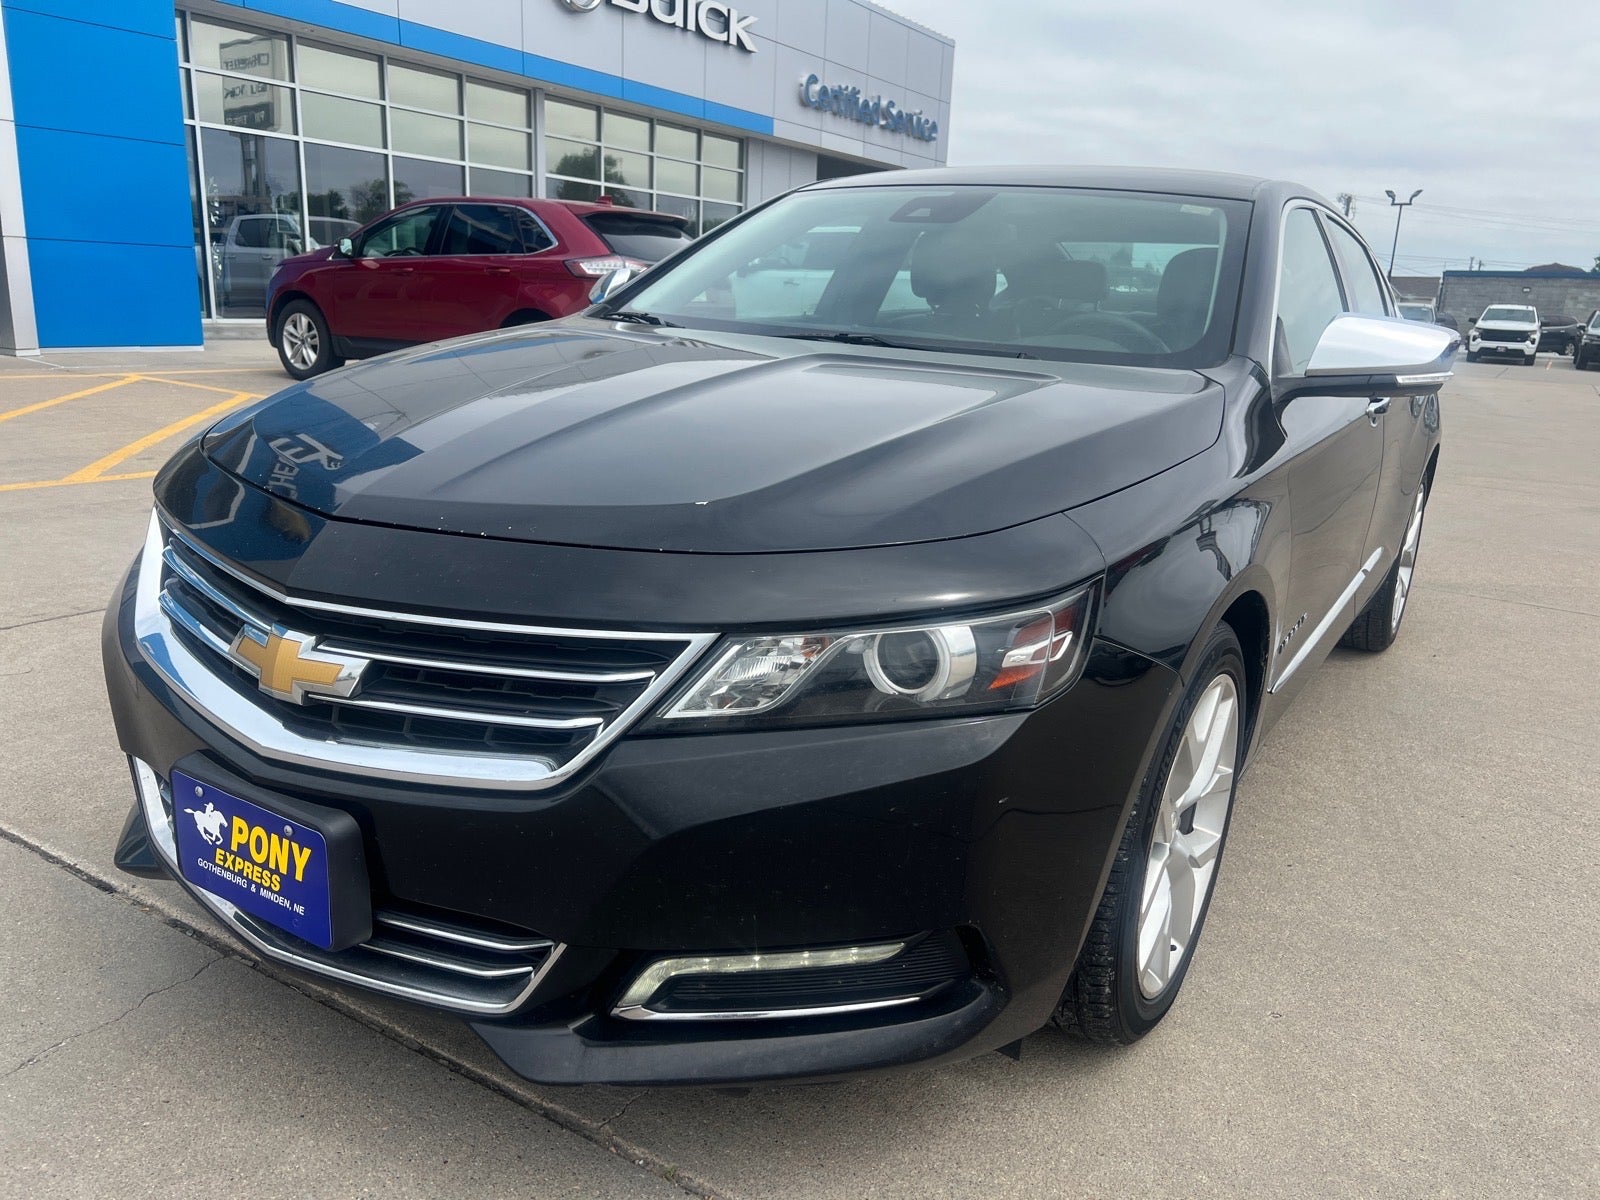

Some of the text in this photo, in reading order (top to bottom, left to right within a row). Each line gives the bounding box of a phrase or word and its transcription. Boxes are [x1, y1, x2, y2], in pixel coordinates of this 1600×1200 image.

[803, 73, 939, 142] Certified Service
[214, 847, 281, 892] EXPRESS
[230, 815, 312, 882] PONY
[197, 857, 305, 916] GOTHENBURG & MINDEN, NE
